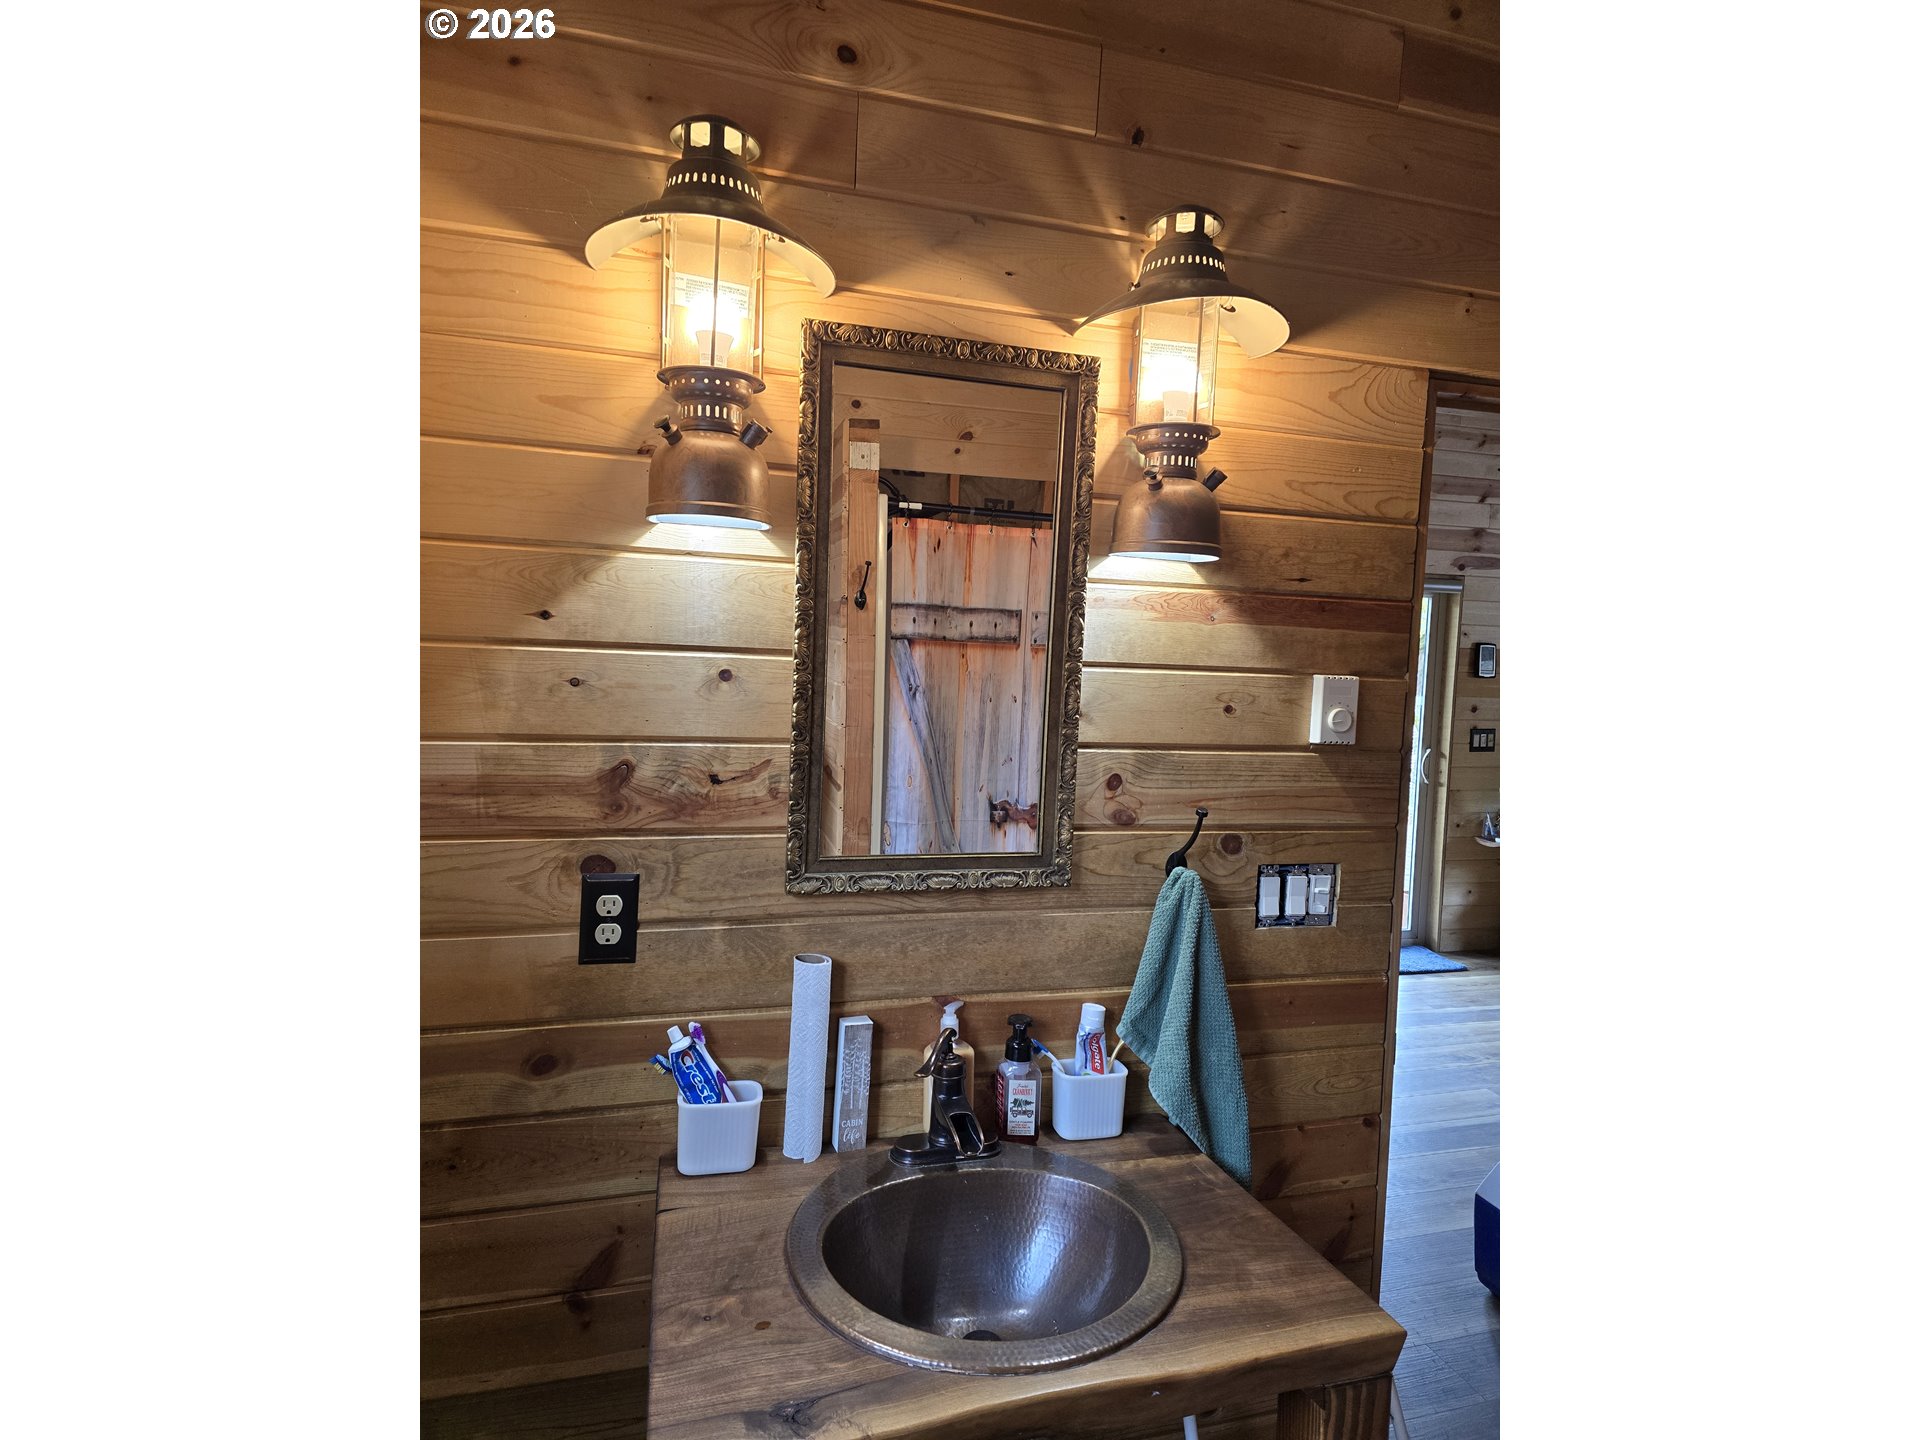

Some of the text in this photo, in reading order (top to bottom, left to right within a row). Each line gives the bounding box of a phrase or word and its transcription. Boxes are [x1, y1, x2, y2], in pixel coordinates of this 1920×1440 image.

[680, 1049, 718, 1104] Crest
[841, 1118, 864, 1128] CABIN
[843, 1127, 860, 1145] life
